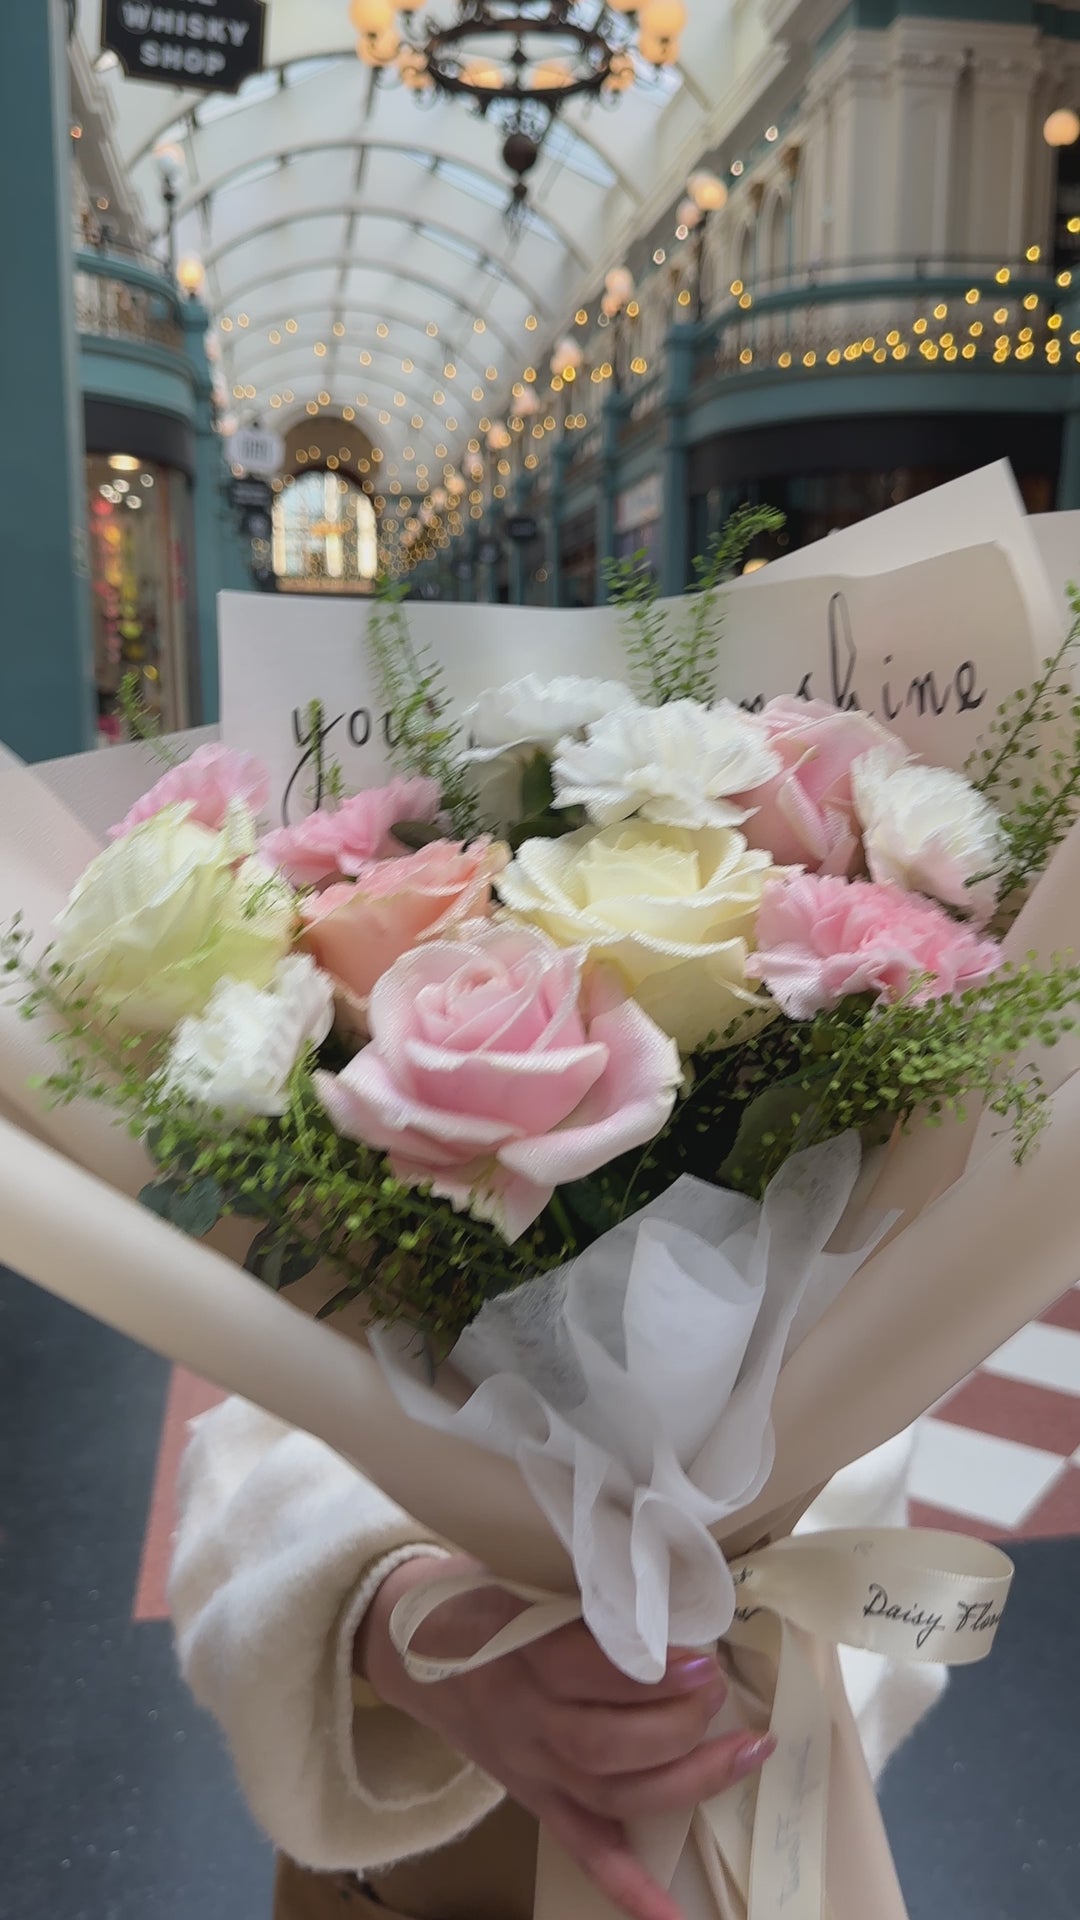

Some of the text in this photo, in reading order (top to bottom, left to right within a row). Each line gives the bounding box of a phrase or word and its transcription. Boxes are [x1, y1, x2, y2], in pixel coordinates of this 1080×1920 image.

[122, 3, 249, 47] WHISKY
[139, 39, 226, 76] SHOP
[863, 1583, 945, 1648] Daisy
